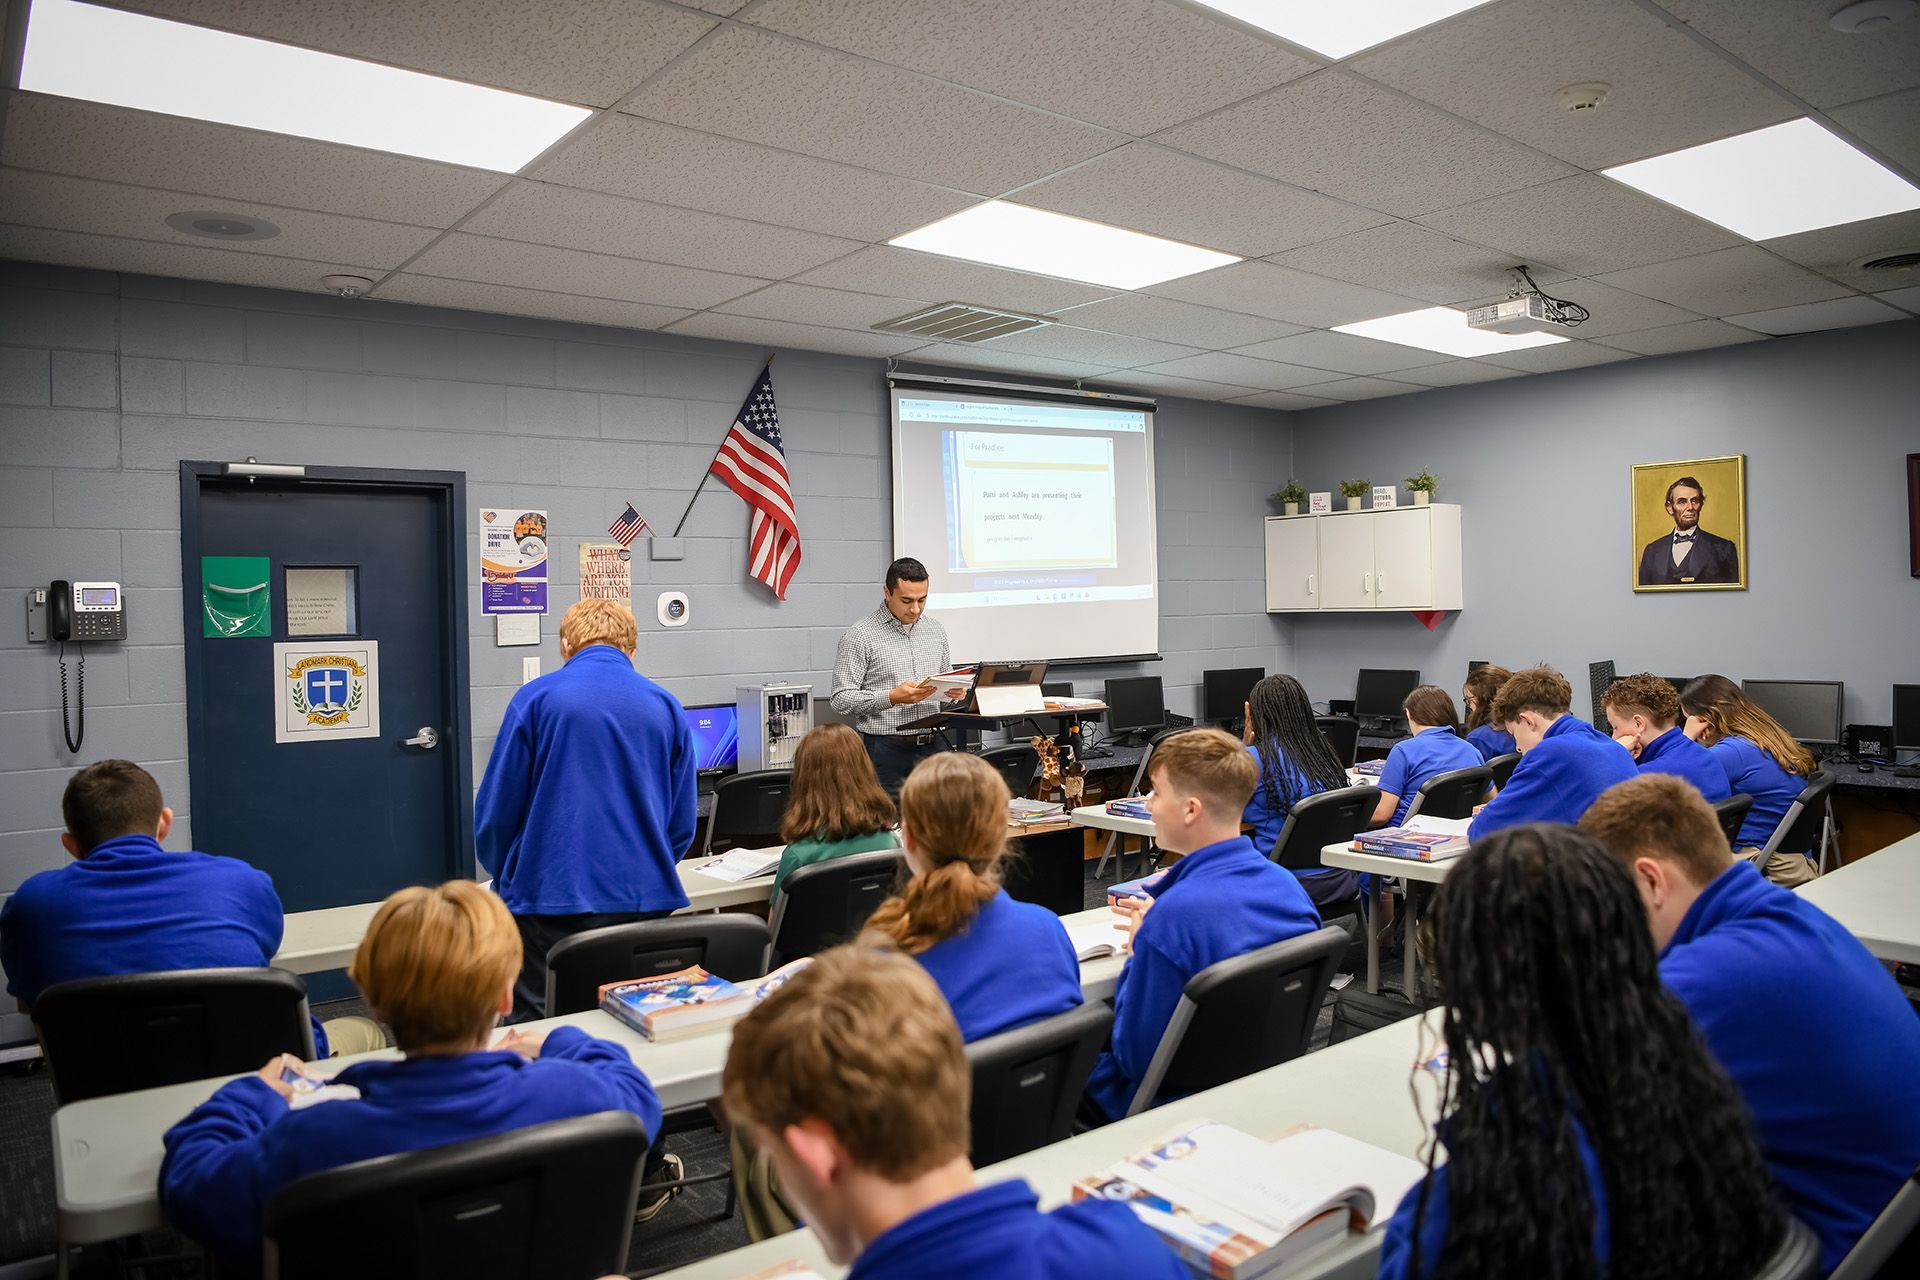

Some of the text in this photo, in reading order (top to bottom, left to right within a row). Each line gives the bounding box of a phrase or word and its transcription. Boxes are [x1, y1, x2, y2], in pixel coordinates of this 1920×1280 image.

[999, 491, 1010, 499] and
[1042, 491, 1068, 501] presenting
[984, 513, 1005, 521] projects
[586, 561, 626, 574] WHERE
[583, 573, 629, 587] ARE YOU
[583, 586, 630, 599] WRITING
[298, 656, 358, 670] LANDMARK CHRISTIAN
[313, 713, 344, 724] ACADEMY
